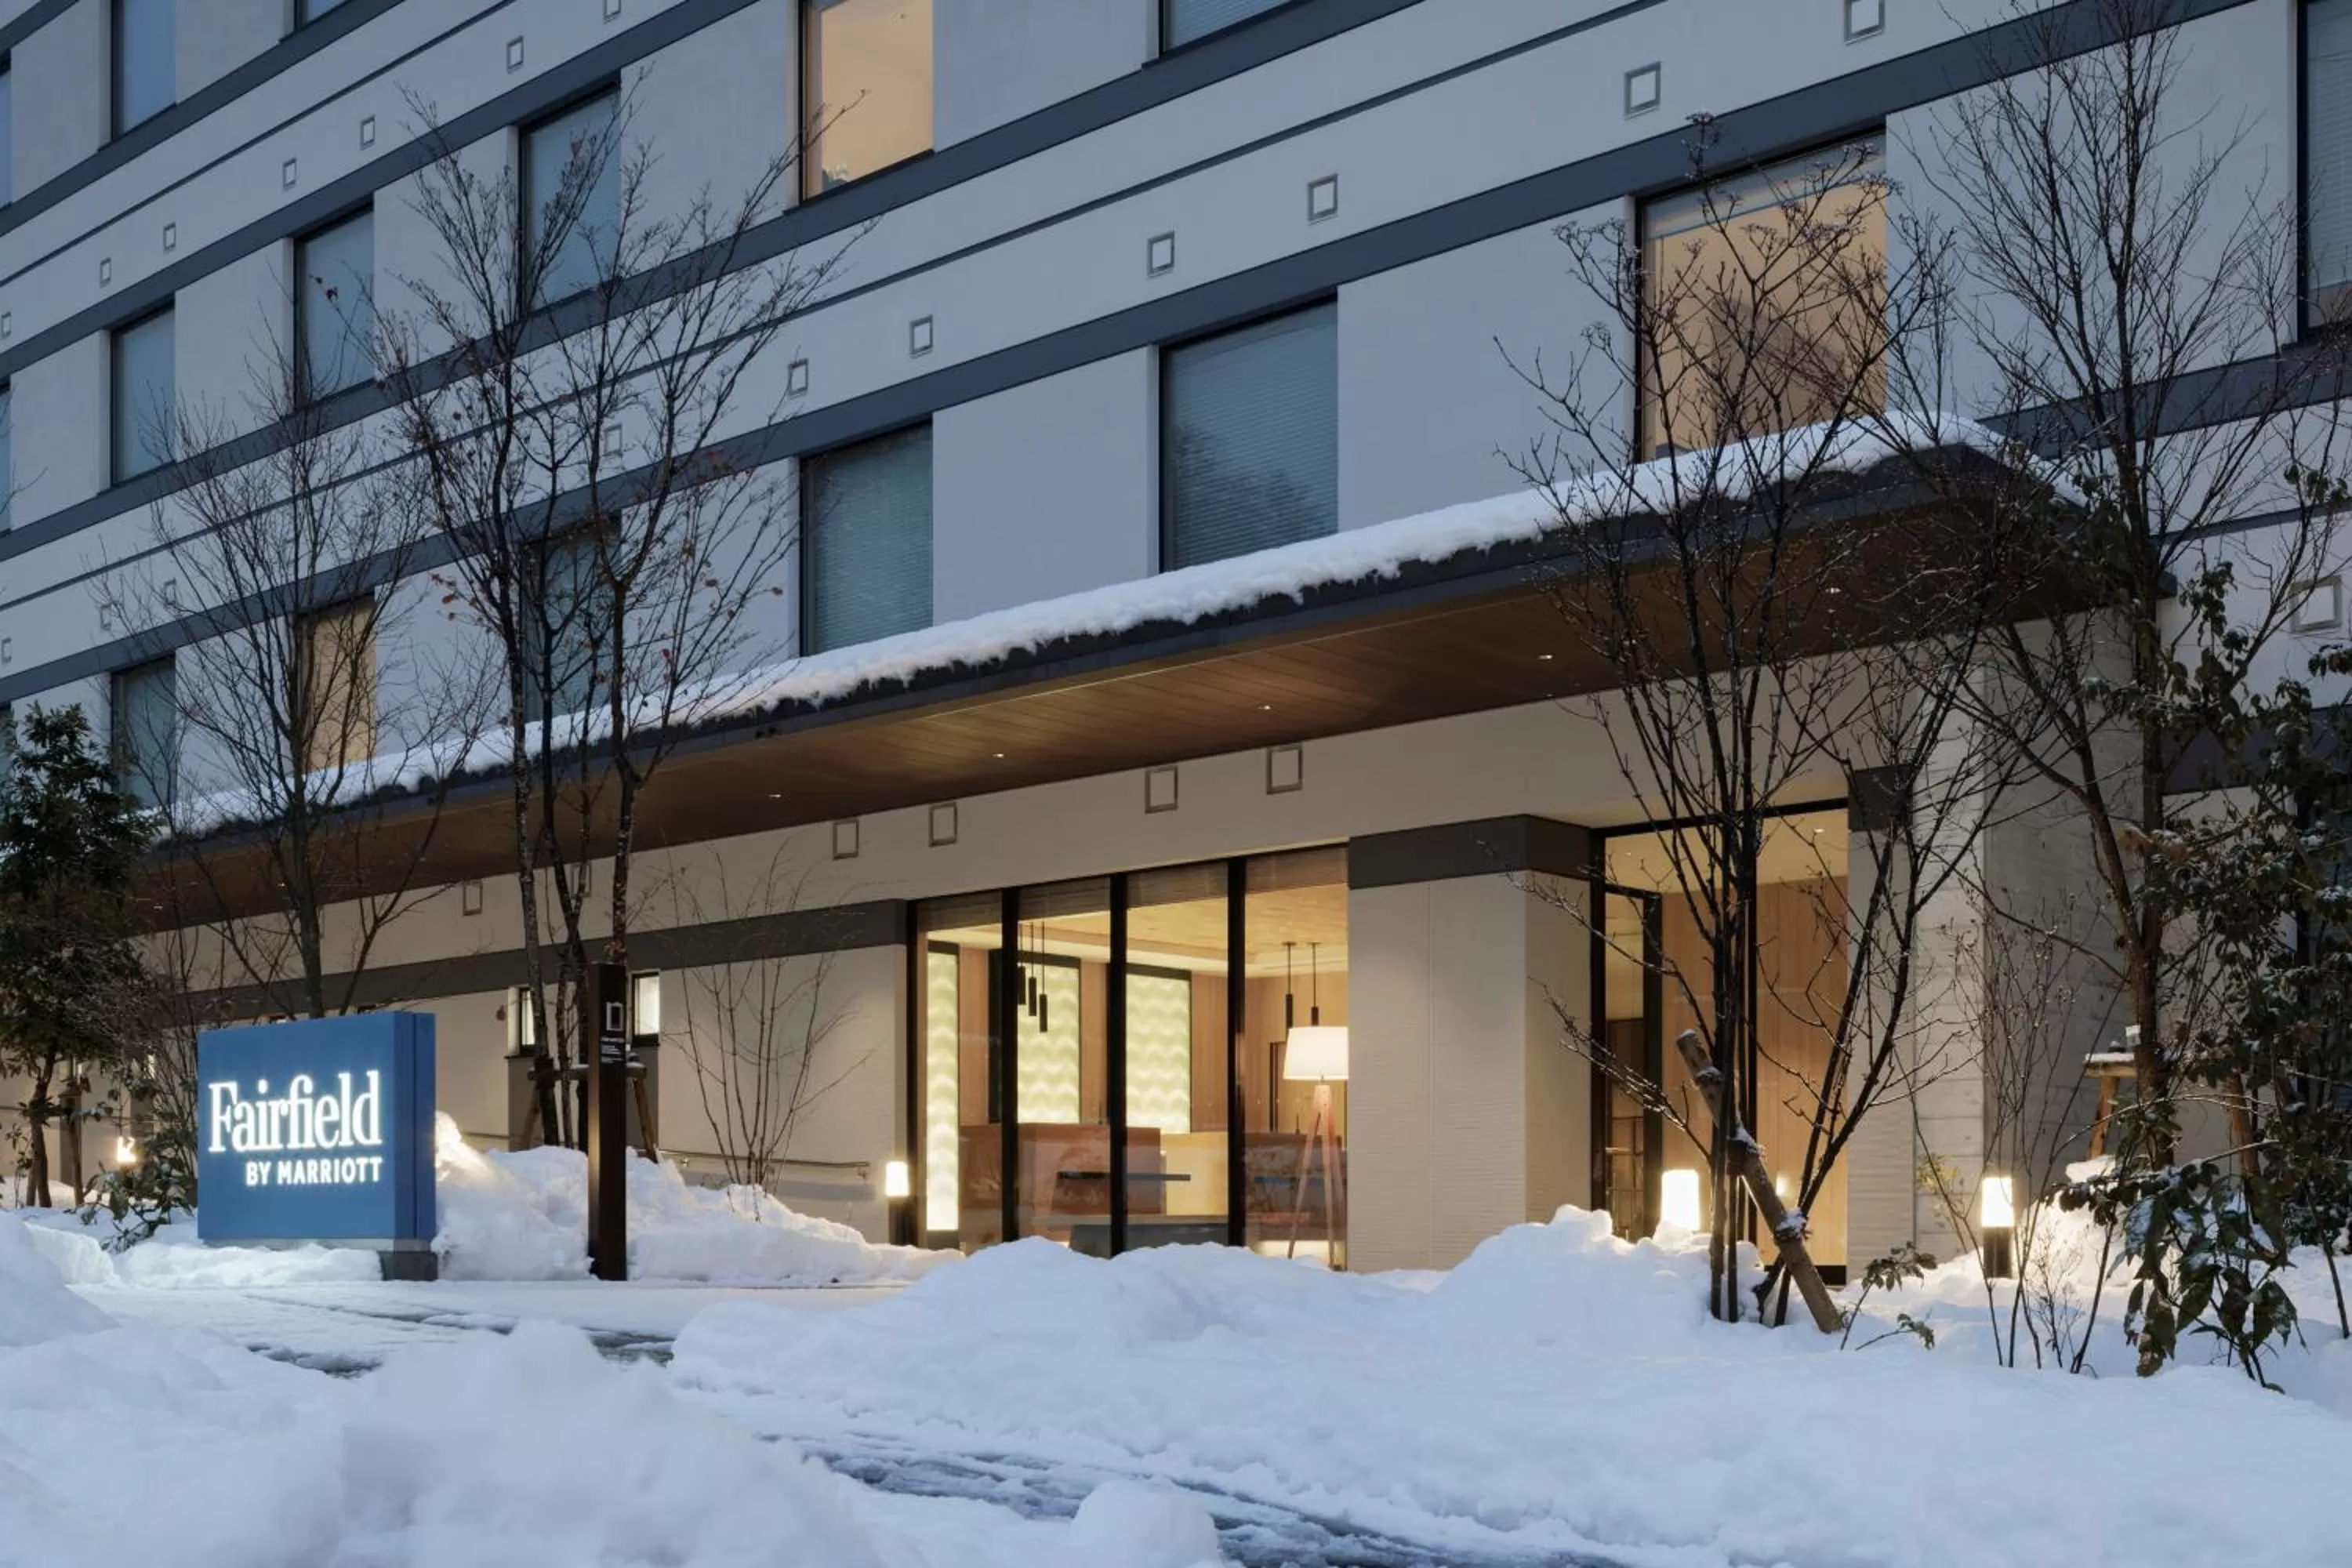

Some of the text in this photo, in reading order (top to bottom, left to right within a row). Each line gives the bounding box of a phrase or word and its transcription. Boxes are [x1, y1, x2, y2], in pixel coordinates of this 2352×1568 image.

[209, 1070, 383, 1152] Fairfield
[246, 1156, 383, 1185] BY MARRIOTT
